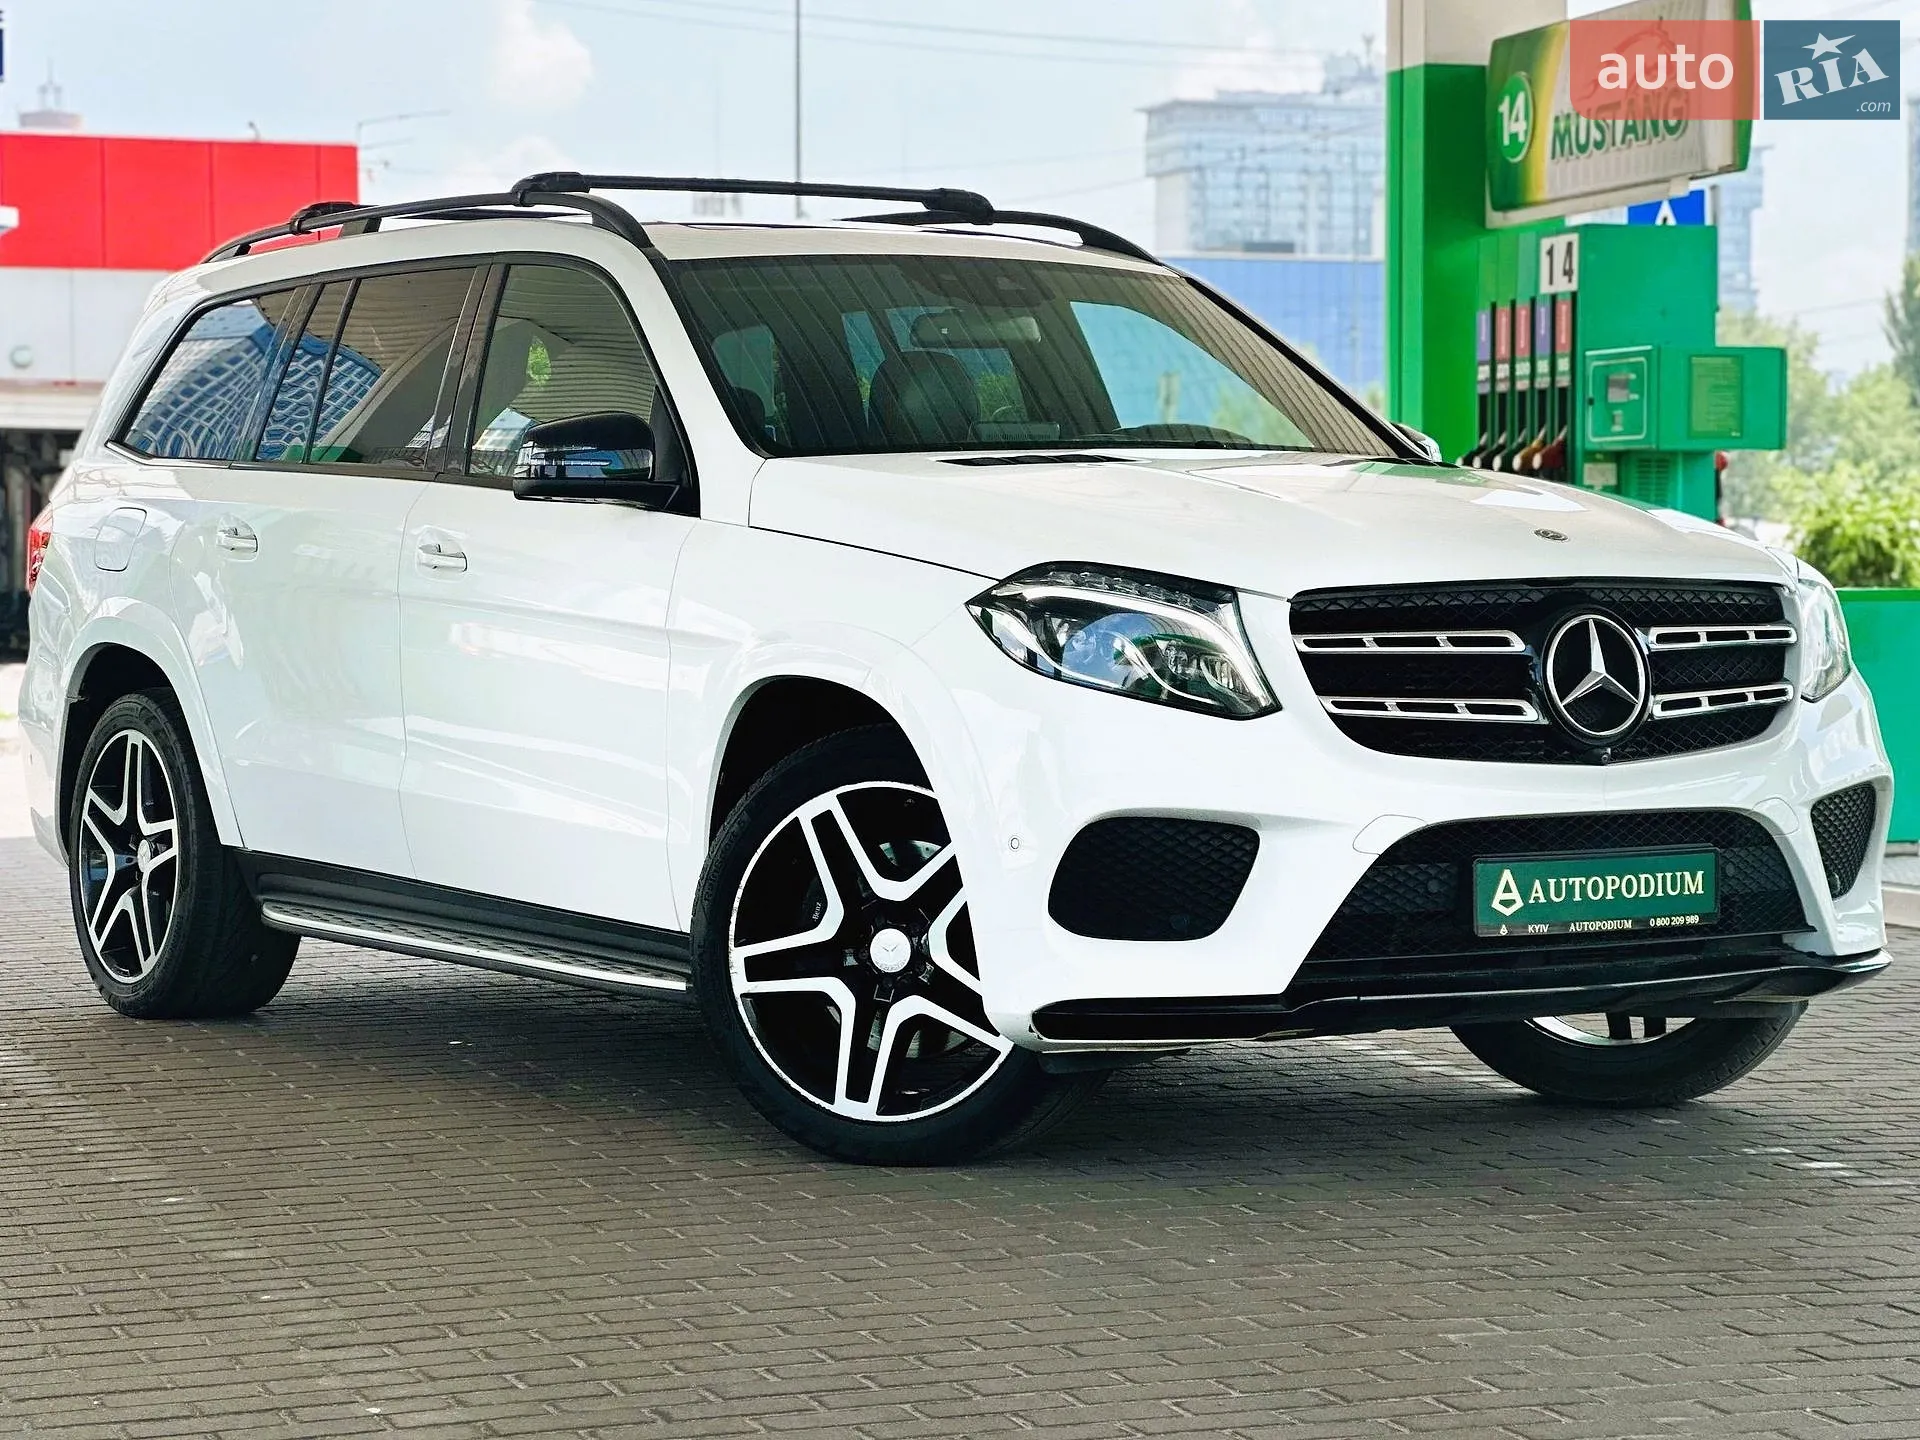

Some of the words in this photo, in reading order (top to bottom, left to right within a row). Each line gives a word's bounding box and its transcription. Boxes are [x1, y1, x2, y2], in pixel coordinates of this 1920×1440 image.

[1498, 91, 1527, 147] 14
[1551, 91, 1689, 161] MUSTANG
[1545, 240, 1574, 286] 14
[1529, 870, 1705, 904] AUTOPODIUM
[1528, 923, 1550, 934] KYIV
[1568, 919, 1633, 933] AUTOPODIUM
